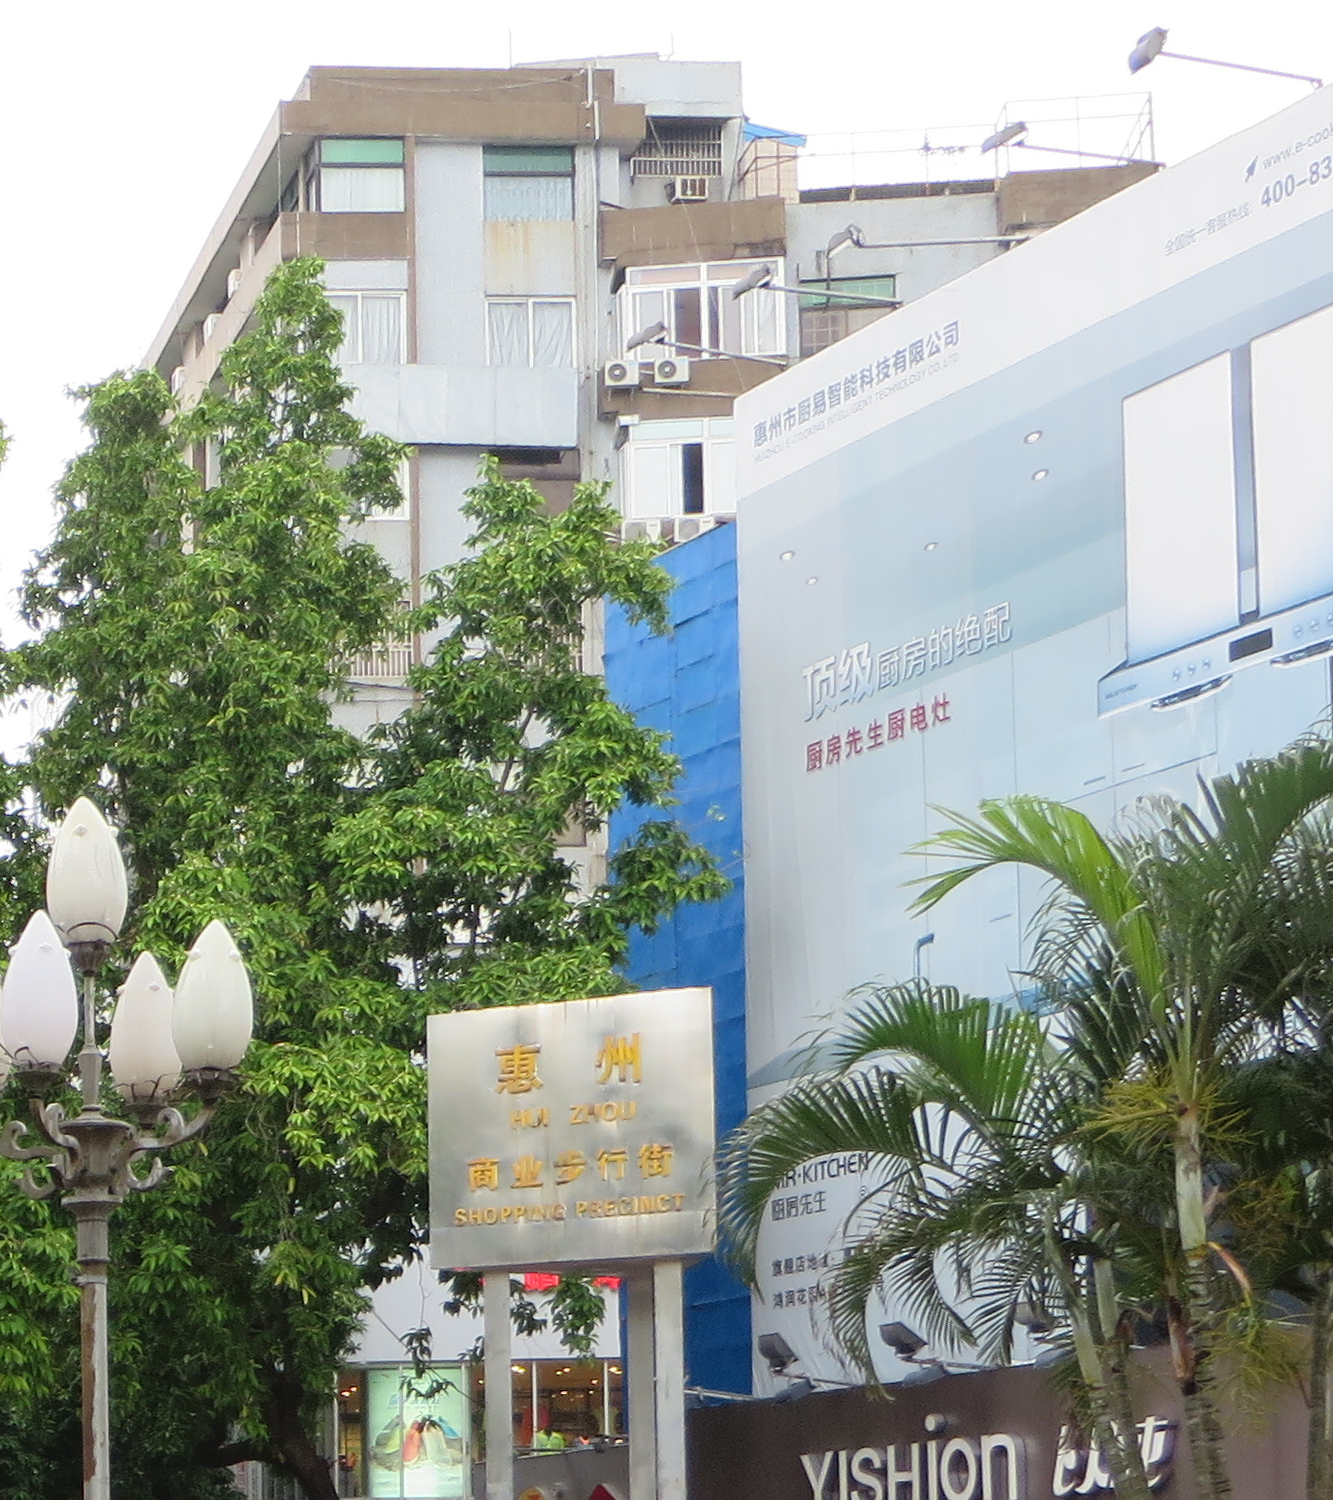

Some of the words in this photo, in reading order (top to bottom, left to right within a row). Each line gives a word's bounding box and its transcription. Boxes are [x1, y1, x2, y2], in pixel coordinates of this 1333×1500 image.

[753, 320, 960, 448] 惠州市厨易智能科技有限公司
[801, 601, 1013, 723] 顶级厨房的绝配
[806, 693, 951, 772] 厨房先生厨电灶
[494, 1032, 643, 1095] 惠州
[510, 1107, 550, 1129] HUI
[568, 1101, 637, 1126] ZHOU
[466, 1143, 675, 1192] 商业步行街
[454, 1202, 567, 1228] SHOPPING
[575, 1194, 686, 1220] PRECINCT
